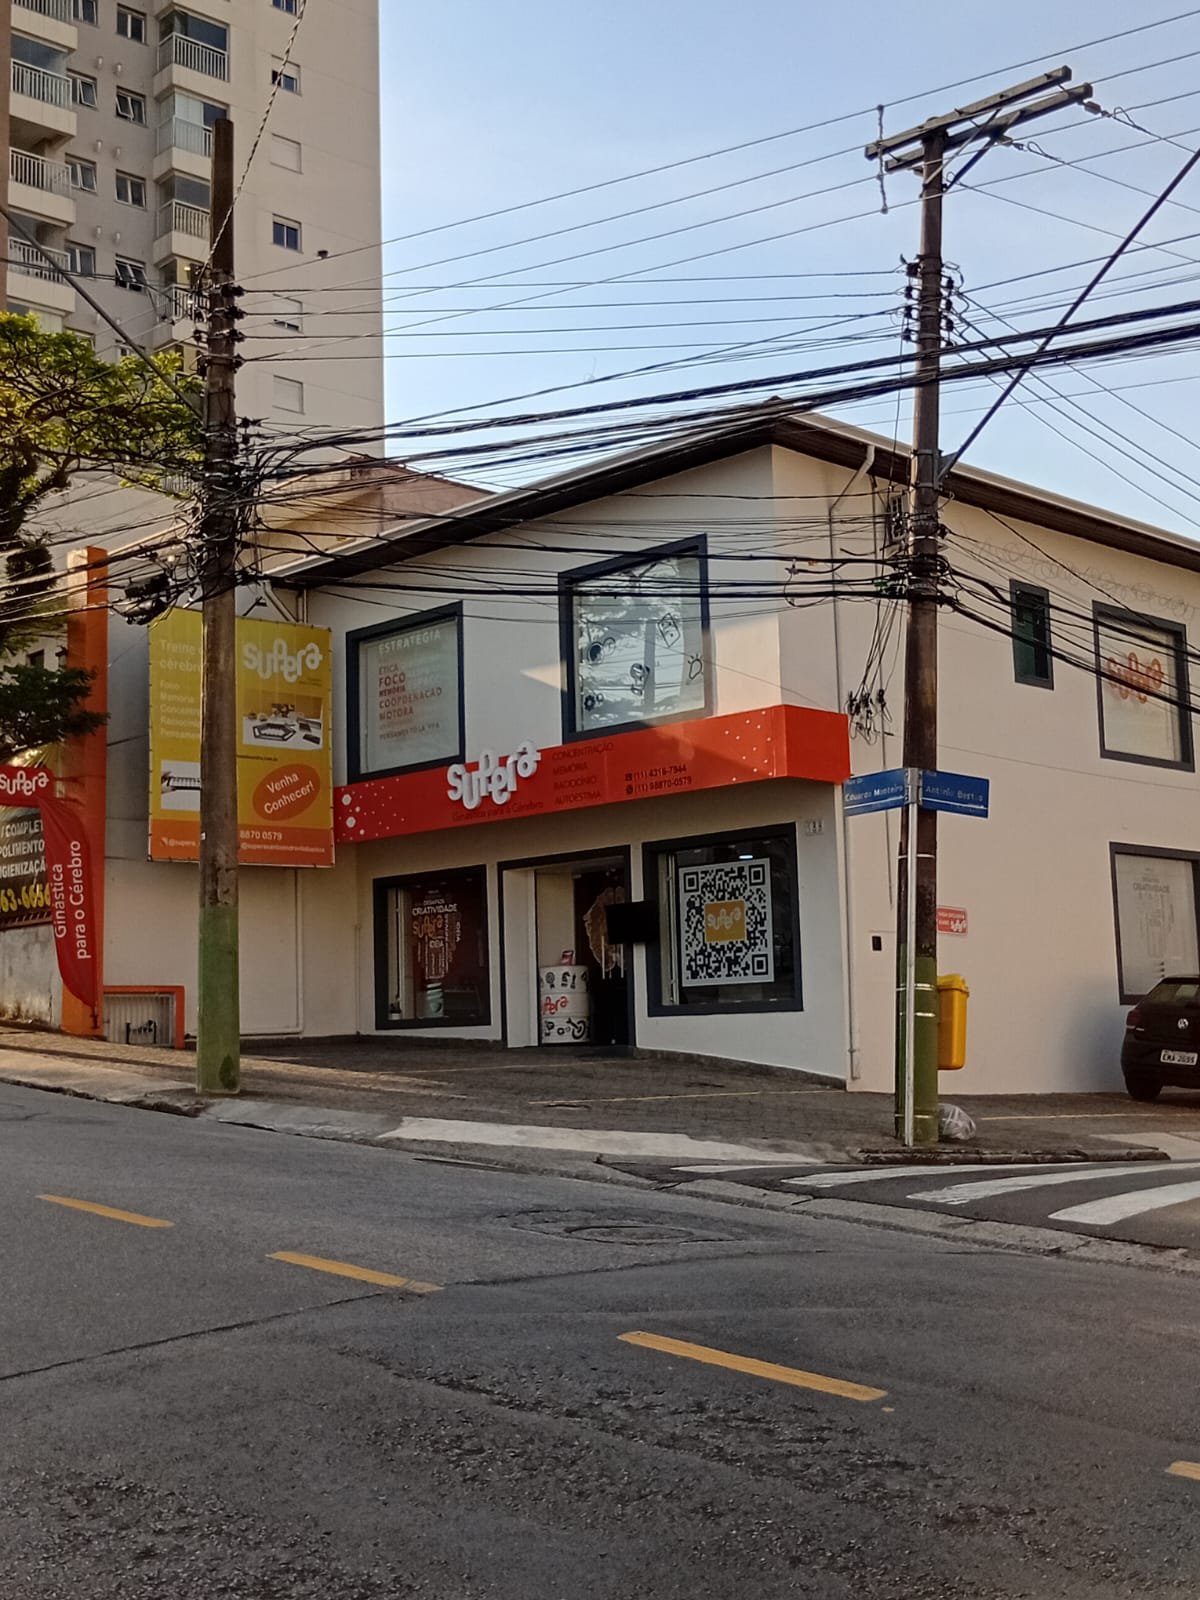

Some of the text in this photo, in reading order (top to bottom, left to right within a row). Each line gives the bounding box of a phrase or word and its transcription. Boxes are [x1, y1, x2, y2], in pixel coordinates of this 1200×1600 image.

[378, 671, 406, 688] FOCO
[264, 780, 315, 814] Conhecer!
[266, 773, 300, 794] Venha
[52, 863, 67, 938] Ginástica
[68, 840, 91, 960] para o Cérebro
[411, 903, 459, 917] CRIATIVIDADE
